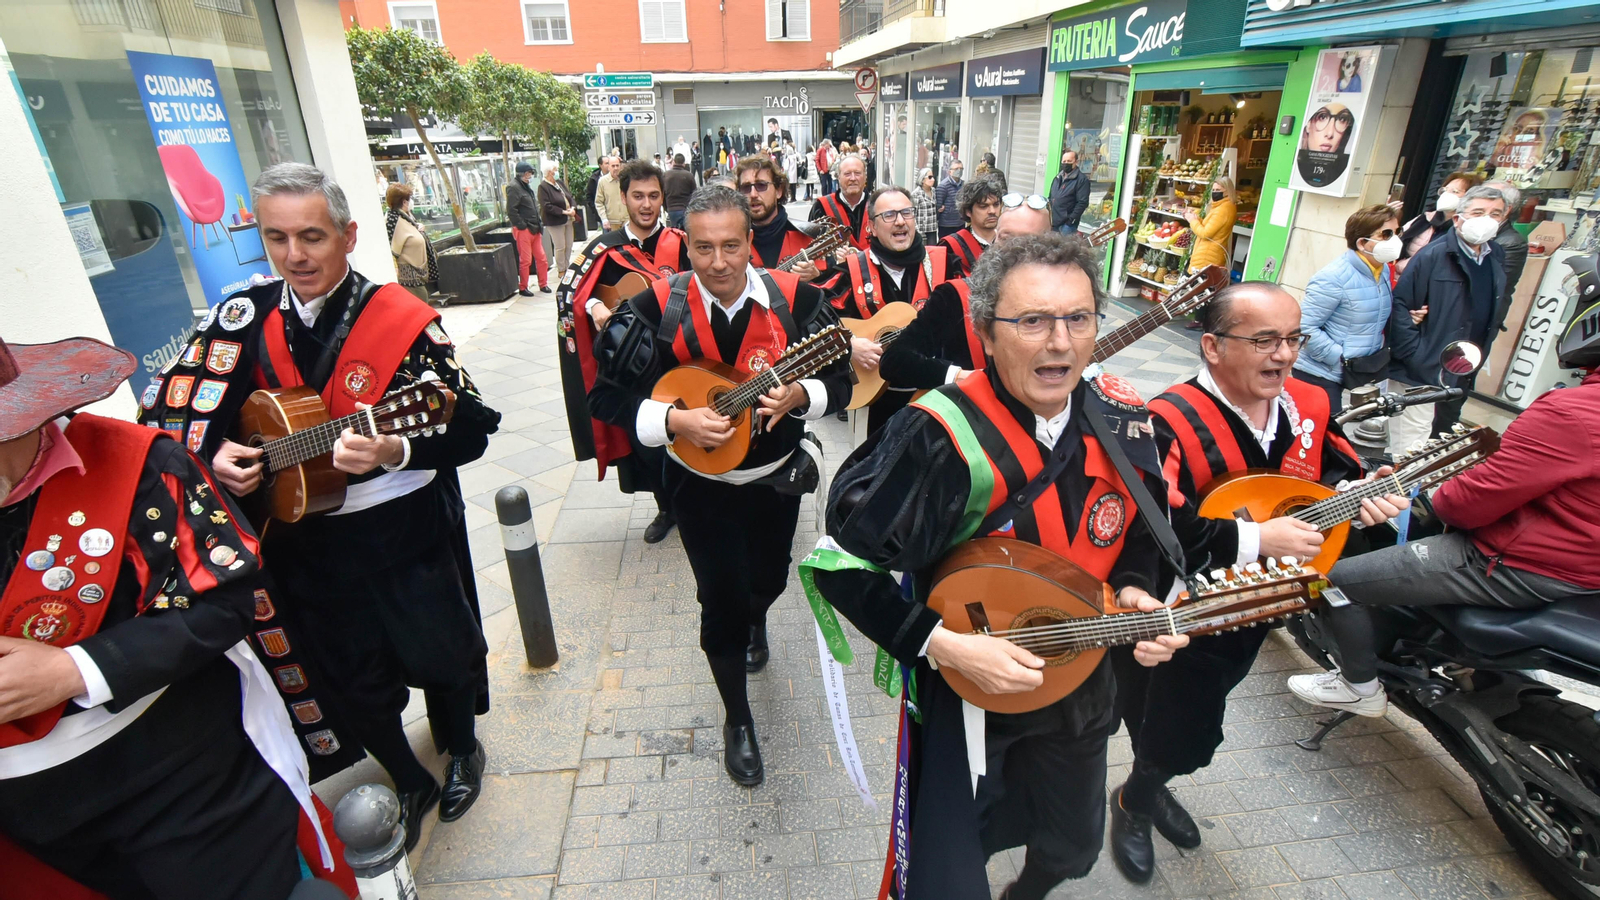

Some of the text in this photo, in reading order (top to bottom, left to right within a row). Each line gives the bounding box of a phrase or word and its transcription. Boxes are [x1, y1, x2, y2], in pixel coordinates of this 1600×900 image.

[1050, 17, 1117, 63] FRUTERIA
[923, 75, 935, 92] Aural
[982, 65, 1002, 87] Aural
[144, 74, 216, 98] CUIDAMOS
[885, 82, 893, 95] Aural
[149, 102, 173, 123] DE
[170, 102, 192, 122] TU
[191, 103, 226, 122] CASA
[158, 125, 231, 145] COMO TÚ LO HACES
[407, 143, 421, 153] LA
[1497, 154, 1537, 164] GUESS
[1535, 234, 1555, 242] GUESS
[1504, 295, 1559, 402] GUESS
[1107, 398, 1118, 407] DE
[1118, 402, 1138, 412] TUNA
